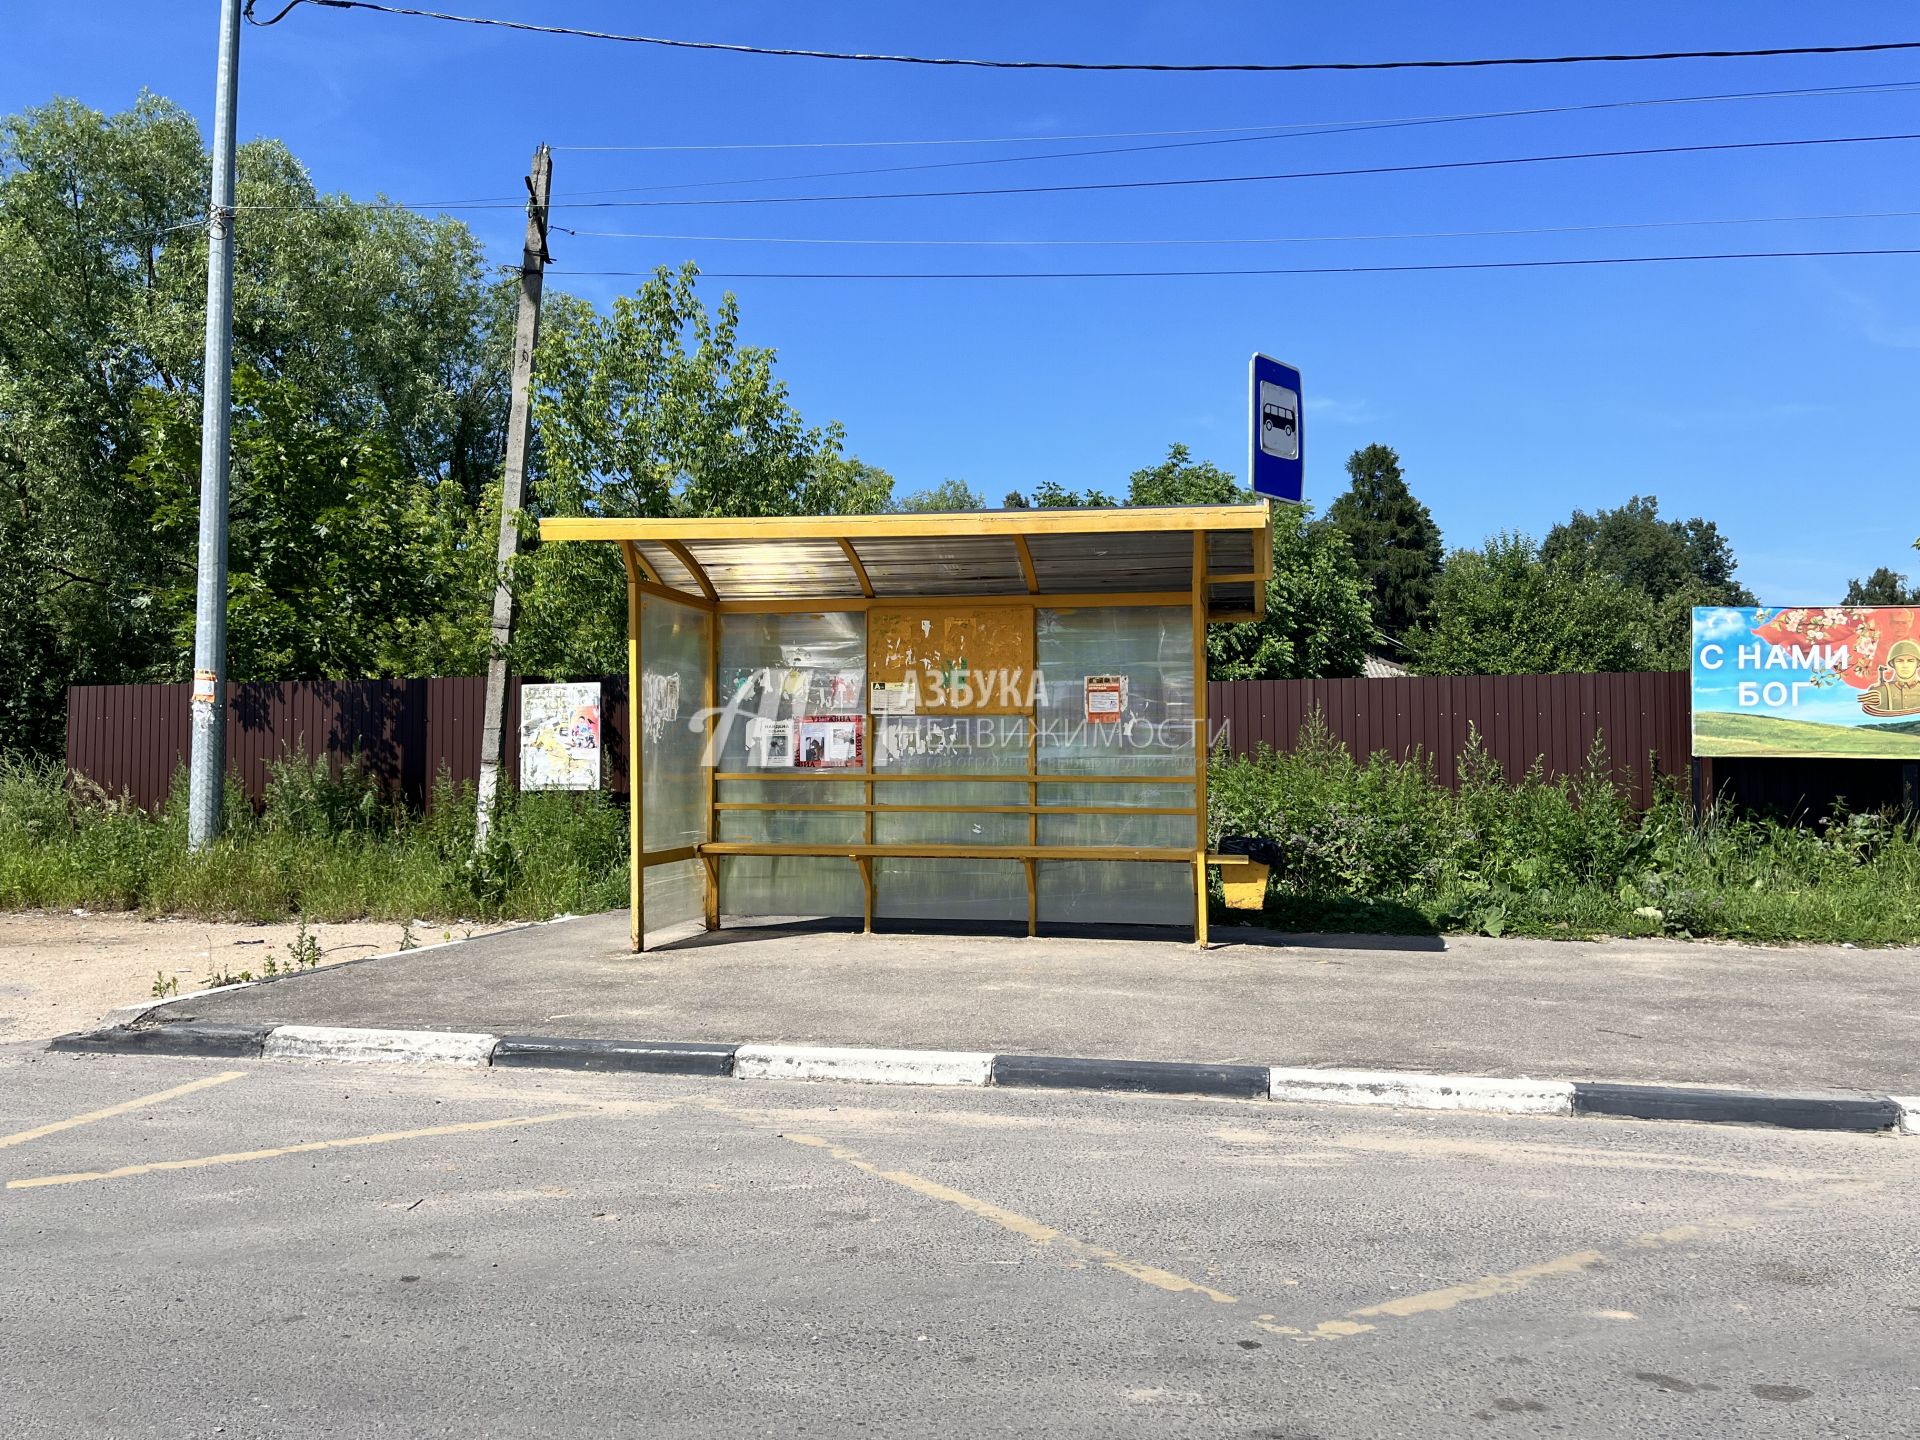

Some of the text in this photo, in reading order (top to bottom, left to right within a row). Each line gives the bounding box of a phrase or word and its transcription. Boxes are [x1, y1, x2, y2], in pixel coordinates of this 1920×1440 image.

[1699, 644, 1849, 670] С НАМИ
[1738, 681, 1811, 707] БОГ
